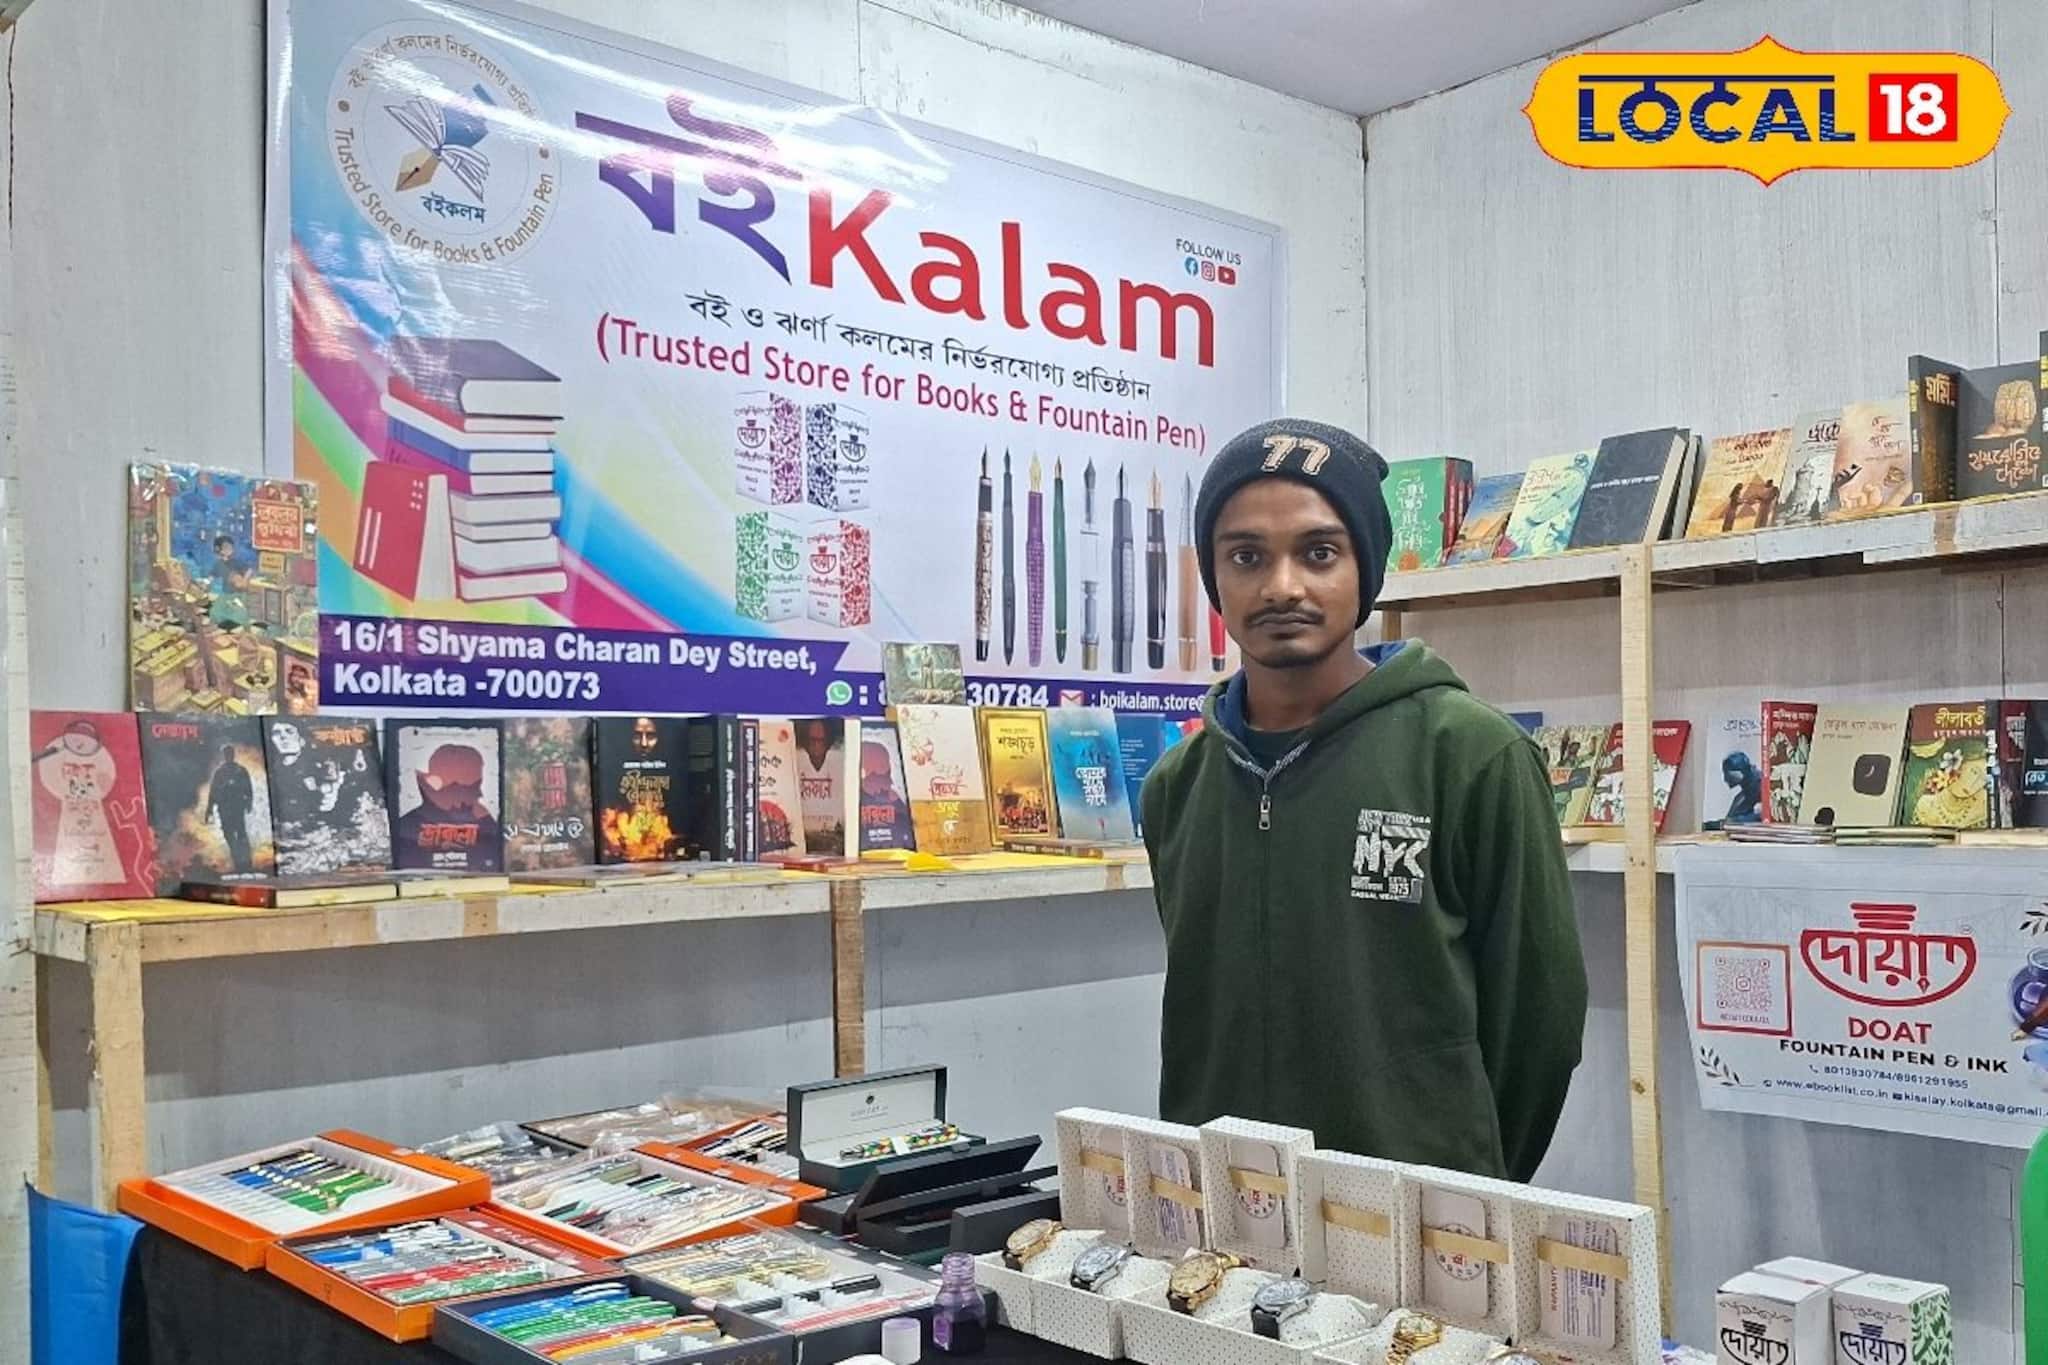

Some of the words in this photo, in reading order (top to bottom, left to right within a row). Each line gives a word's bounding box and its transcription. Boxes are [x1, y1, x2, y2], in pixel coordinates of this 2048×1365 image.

[333, 127, 368, 206] Trusted
[362, 191, 402, 239] Store
[403, 228, 431, 254] for
[432, 239, 480, 264] Books
[496, 208, 545, 258] Fountain
[532, 172, 553, 208] Pen
[421, 191, 487, 225] বইকলম
[1176, 238, 1225, 261] FOLLOW
[1226, 250, 1242, 266] US
[686, 289, 732, 320] বই
[741, 306, 764, 330] ও
[775, 310, 829, 346] ঝর্ণা
[836, 322, 935, 361] কলমের
[944, 335, 1066, 388] নির্ভরযোগ্য
[1072, 367, 1152, 403] প্রতিষ্ঠান
[596, 312, 751, 376] (Trusted
[763, 346, 849, 392] Store
[861, 362, 905, 400] for
[917, 373, 999, 419] Books
[1008, 391, 1028, 421] &
[1038, 394, 1149, 443] Fountain
[1155, 414, 1206, 455] Pen)
[1262, 433, 1332, 476] 77
[334, 621, 403, 655] 16/1
[417, 627, 545, 668] Shyama
[555, 632, 661, 666] Charan
[670, 633, 719, 673] Dey
[729, 640, 817, 675] Street,
[334, 662, 466, 697] Kolkata
[476, 671, 600, 701] -700073
[1848, 1016, 1932, 1045] DOAT
[1779, 1039, 1886, 1062] FOUNTAIN
[1892, 1049, 1935, 1067] PEN
[1944, 1053, 1960, 1068] &
[1967, 1056, 2008, 1074] INK
